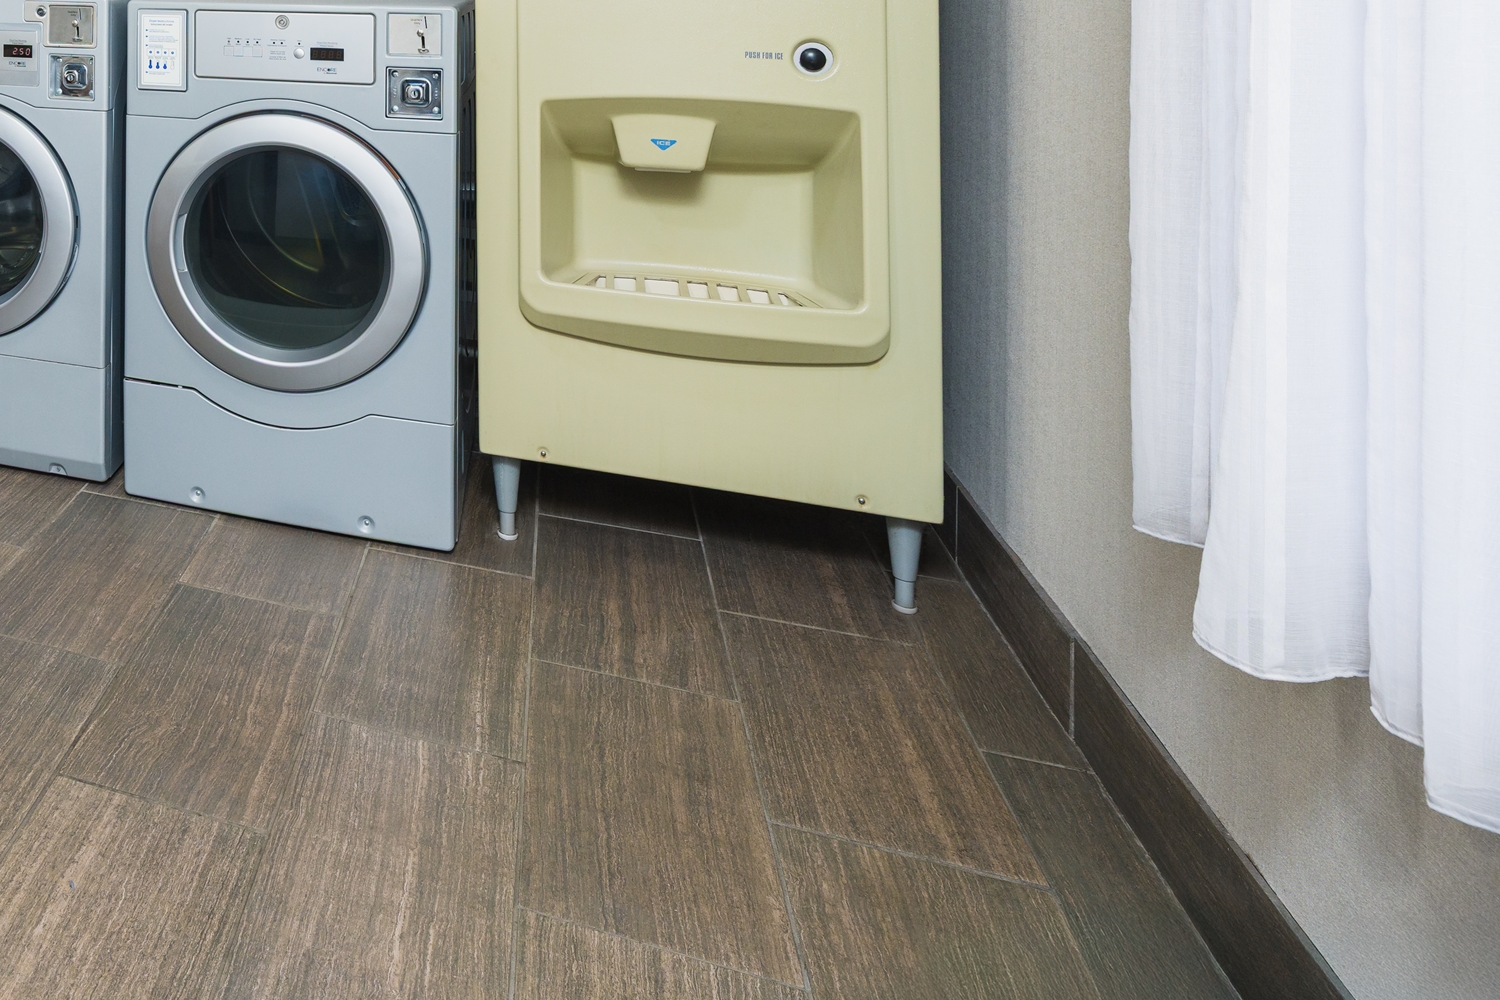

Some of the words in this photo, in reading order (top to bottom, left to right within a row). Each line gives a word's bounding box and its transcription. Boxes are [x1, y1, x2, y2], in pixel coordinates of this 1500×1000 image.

[744, 51, 761, 59] PUSH
[762, 51, 773, 60] FOR
[774, 52, 784, 60] ICE
